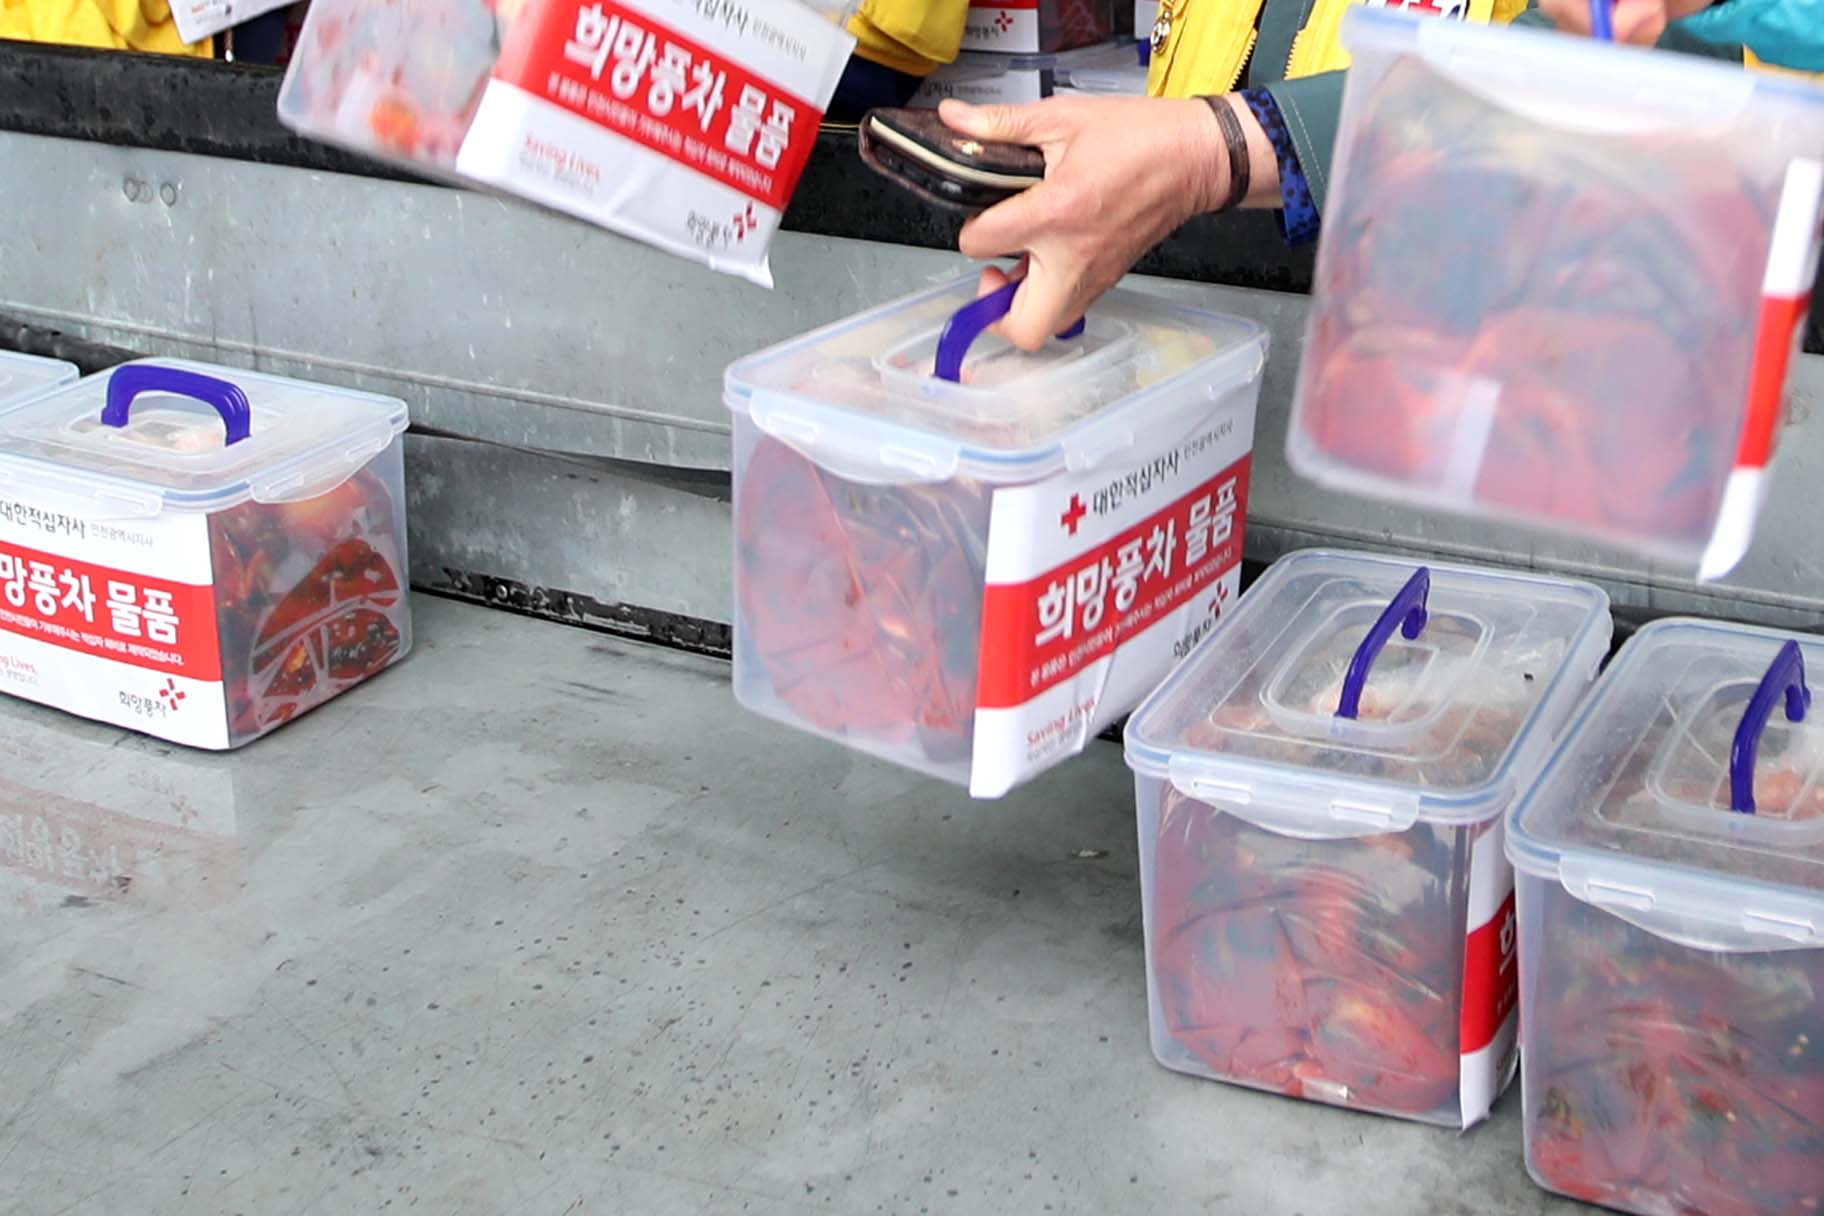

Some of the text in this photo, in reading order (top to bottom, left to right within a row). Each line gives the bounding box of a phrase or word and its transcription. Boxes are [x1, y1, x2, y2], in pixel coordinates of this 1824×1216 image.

[563, 2, 728, 133] 희망풍차
[723, 82, 796, 171] 물품
[0, 499, 86, 540] 대한적십자사
[1092, 447, 1180, 517] 대한적십자사
[0, 551, 181, 645] 망풍차 물품
[1034, 518, 1177, 646] 희망풍차
[1184, 475, 1238, 568] 물품
